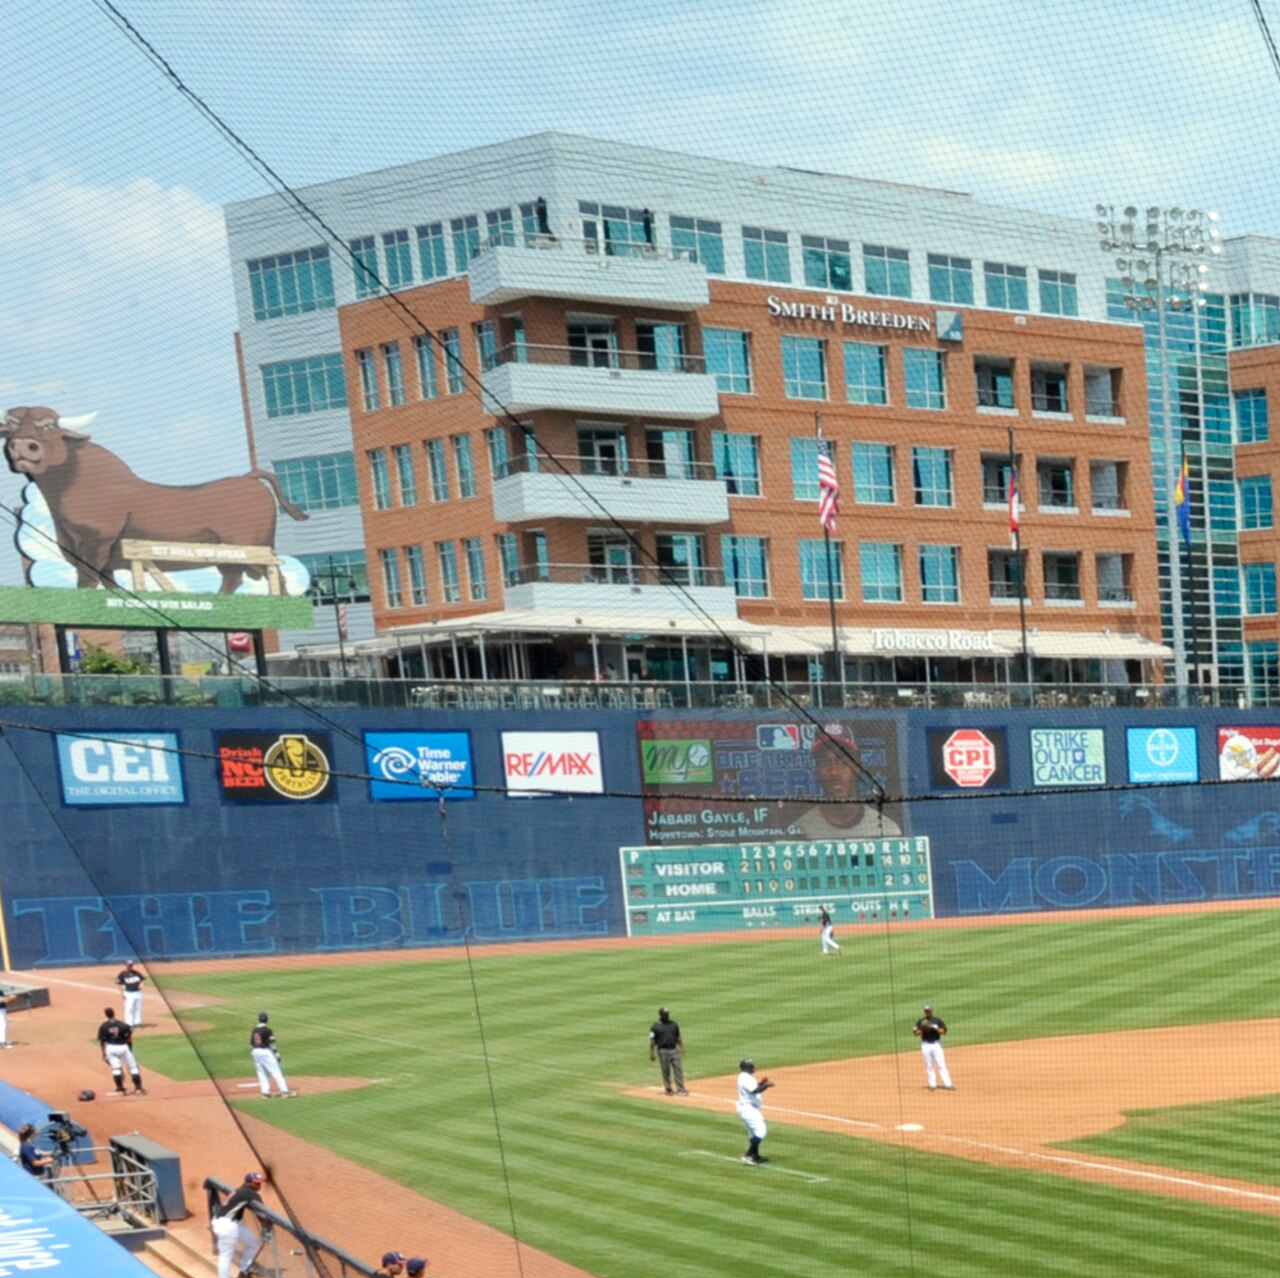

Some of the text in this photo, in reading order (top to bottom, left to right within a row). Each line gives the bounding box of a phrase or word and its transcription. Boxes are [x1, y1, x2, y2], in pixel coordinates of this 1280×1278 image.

[766, 294, 931, 332] SMITH BREEDEN
[871, 629, 994, 652] Tobacco Road
[1033, 731, 1089, 749] STRIKE
[69, 739, 170, 783] CEI
[220, 747, 263, 758] Drink
[417, 746, 451, 759] Time
[949, 749, 991, 767] CPI
[1035, 749, 1070, 765] OUT
[222, 758, 265, 777] NC
[417, 759, 467, 771] Warner
[506, 752, 594, 777] RE/MAX
[1036, 764, 1102, 782] CANCER
[223, 777, 266, 788] BEER
[420, 769, 459, 783] Cable
[649, 807, 769, 826] JABARI GAYLE, IF
[741, 847, 748, 859] 1
[753, 847, 763, 859] 2
[767, 846, 776, 858] 3
[783, 845, 793, 857] 4
[796, 844, 805, 857] 5
[808, 844, 818, 856] 6
[824, 843, 833, 855] 7
[837, 843, 846, 855] 8
[849, 842, 859, 855] 9
[863, 842, 875, 854] 10
[882, 842, 891, 854] R
[899, 841, 909, 853] H
[916, 840, 925, 852] E
[655, 862, 725, 876] VISITOR
[741, 861, 750, 873] 2
[755, 861, 762, 872] 1
[769, 860, 776, 872] 1
[783, 859, 793, 871] 0
[665, 872, 928, 896] HOME 1 1 0 0 2 3 0
[656, 912, 673, 923] AT
[674, 910, 697, 922] BAT
[743, 906, 777, 918] BALLS
[851, 900, 881, 912] OUTS
[13, 889, 276, 967] THE
[311, 876, 611, 953] BLUE
